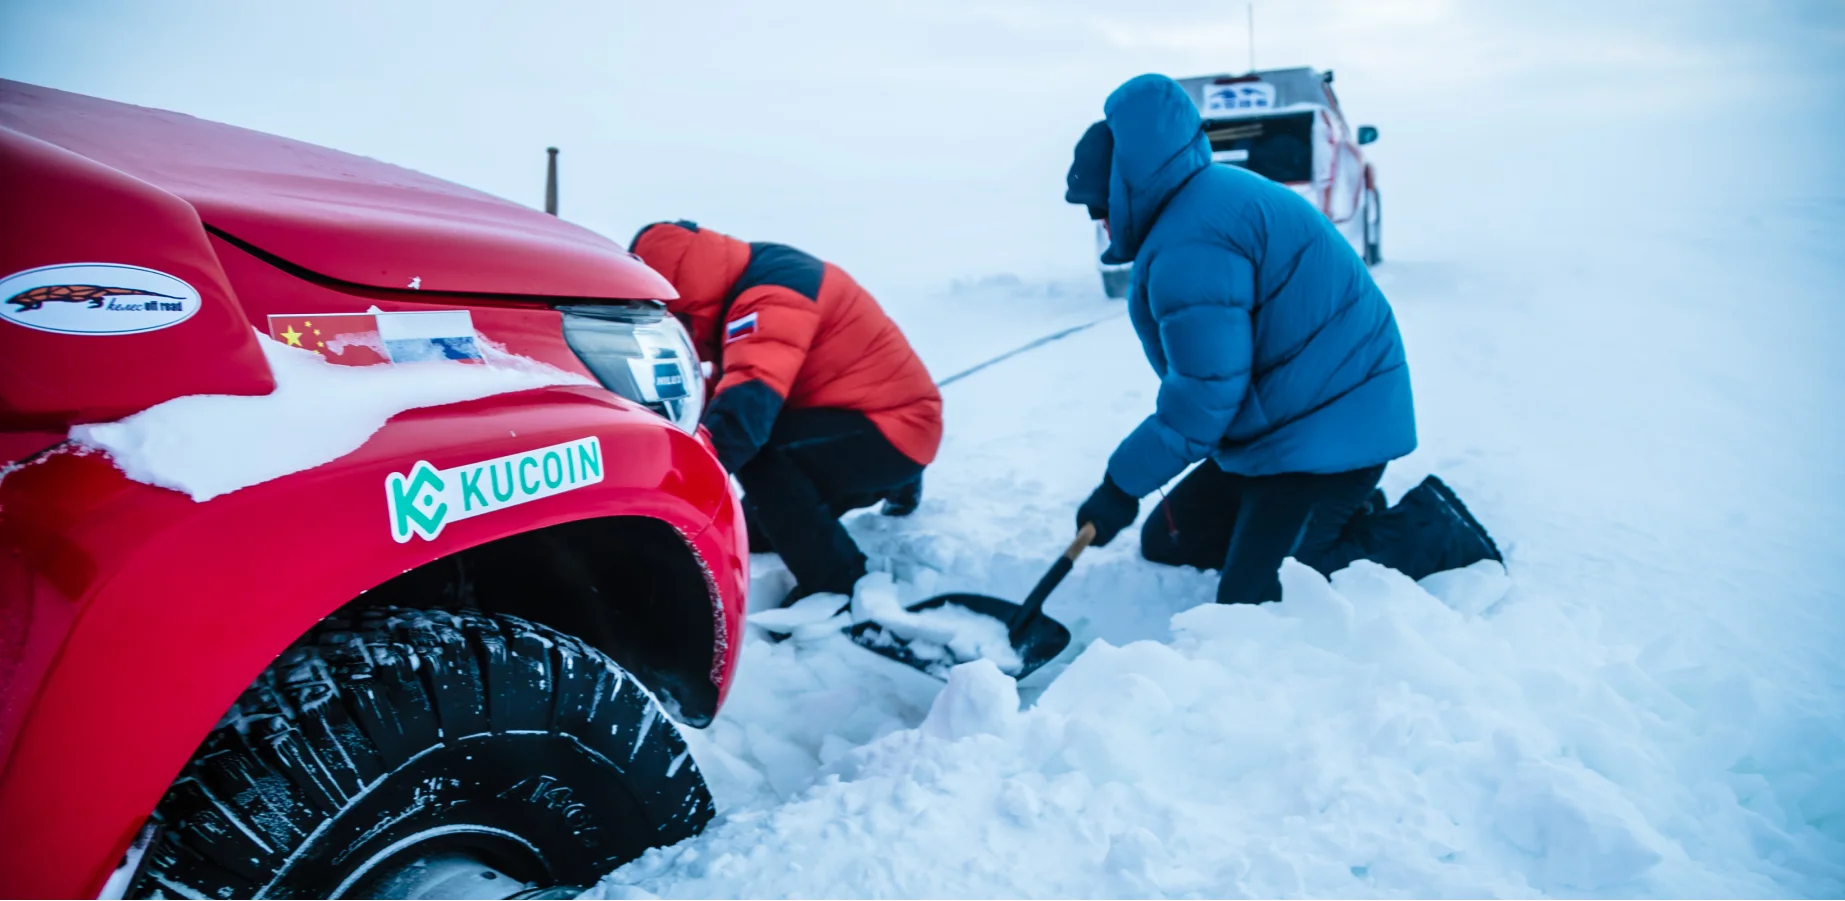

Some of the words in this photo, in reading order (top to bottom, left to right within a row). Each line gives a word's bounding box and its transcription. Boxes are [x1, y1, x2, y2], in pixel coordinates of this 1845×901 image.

[144, 300, 158, 311] off
[159, 300, 183, 311] road
[460, 441, 600, 512] KUCOIN
